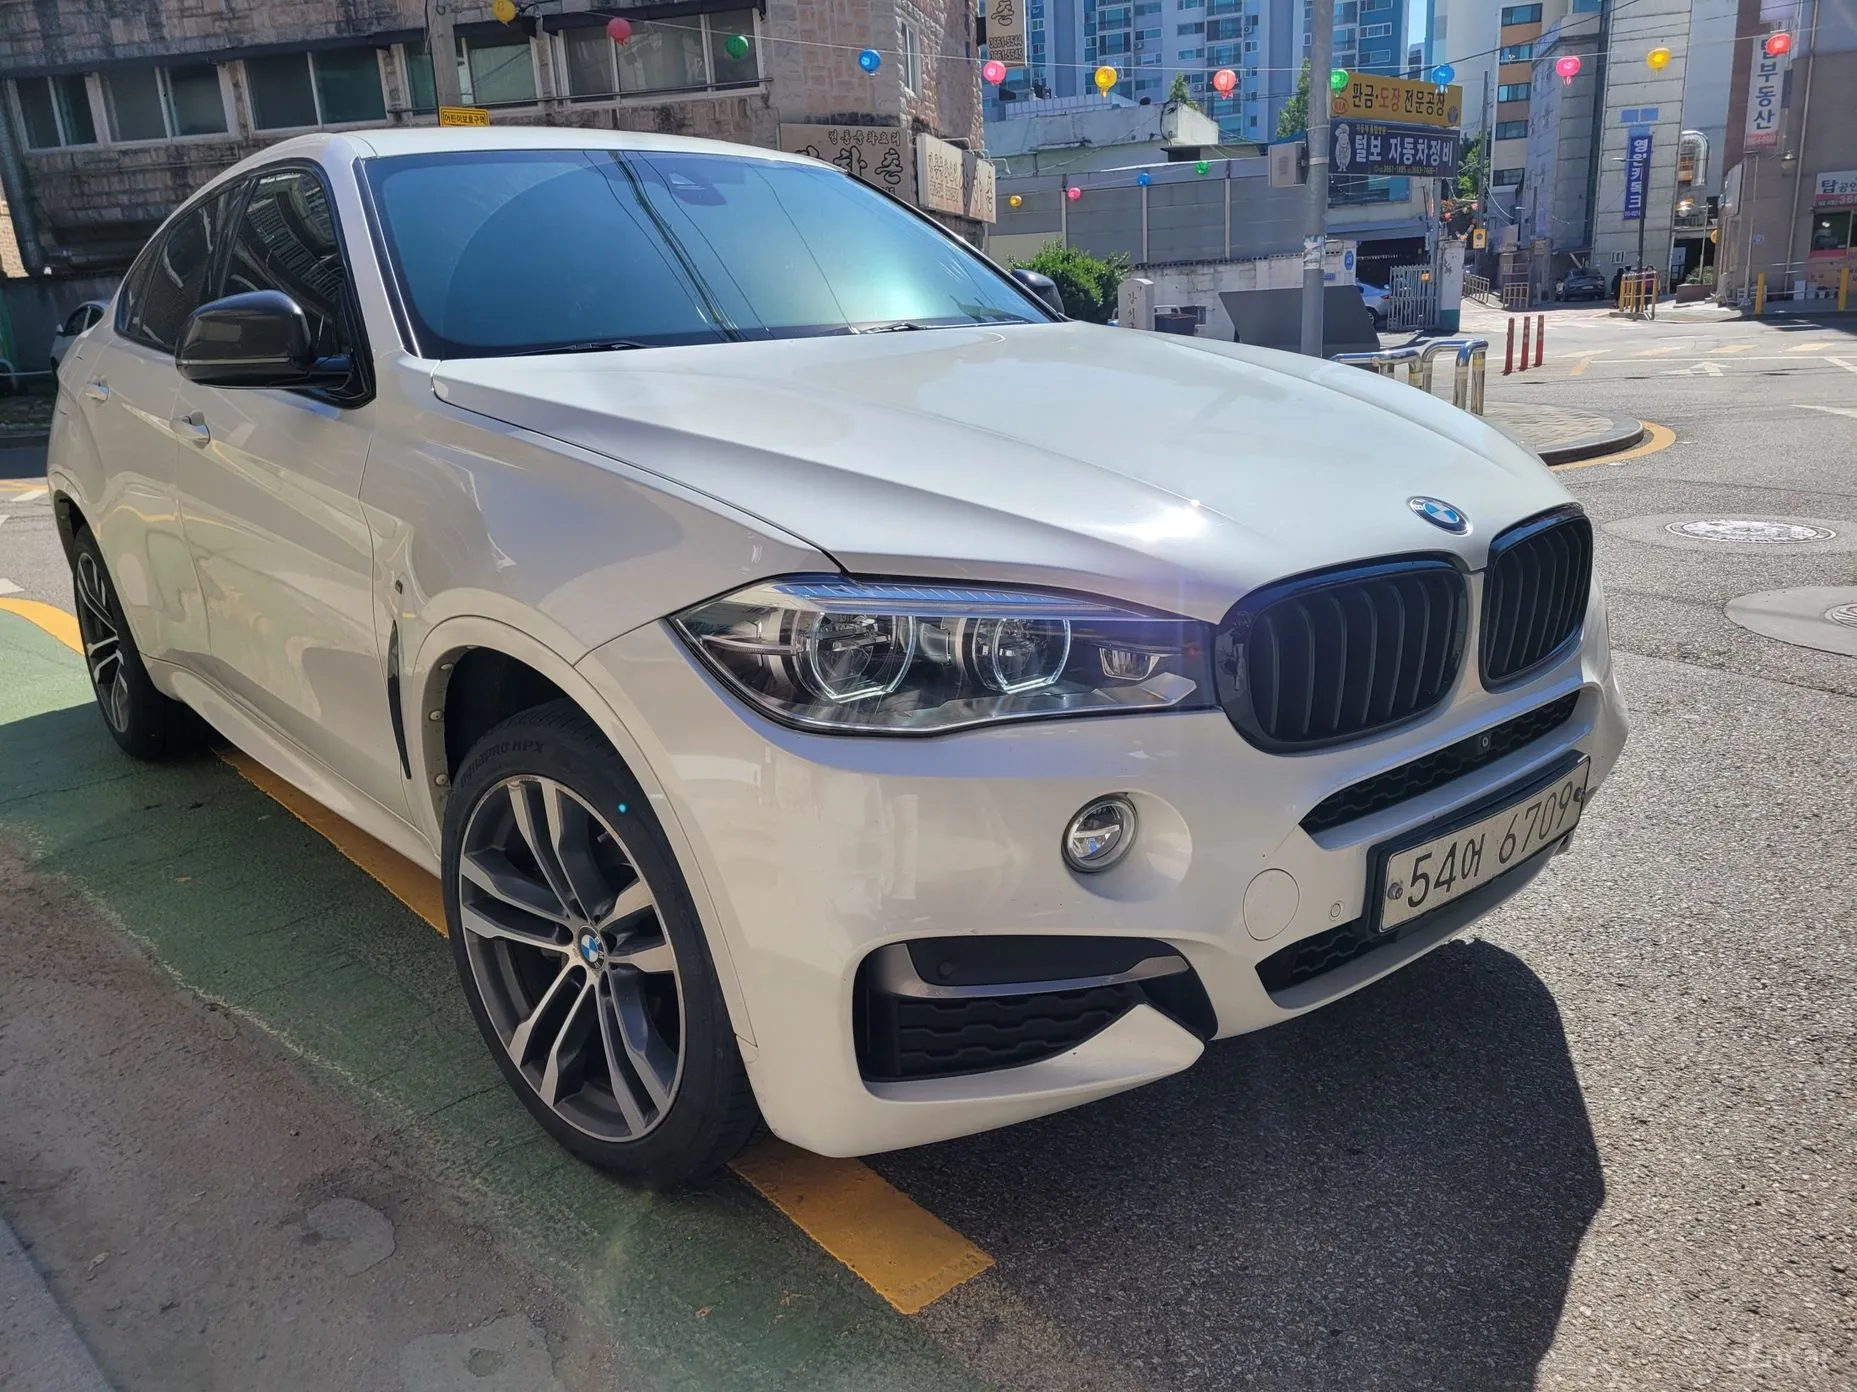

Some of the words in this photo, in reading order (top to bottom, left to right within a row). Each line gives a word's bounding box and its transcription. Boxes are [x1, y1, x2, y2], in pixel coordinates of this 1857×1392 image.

[1405, 89, 1445, 116] 전문공장
[444, 114, 485, 124] 어린이보호구역
[1355, 134, 1382, 162] 털보
[1388, 136, 1453, 166] 자동차정비
[1407, 833, 1486, 907] 54어
[1498, 781, 1573, 864] 6709
